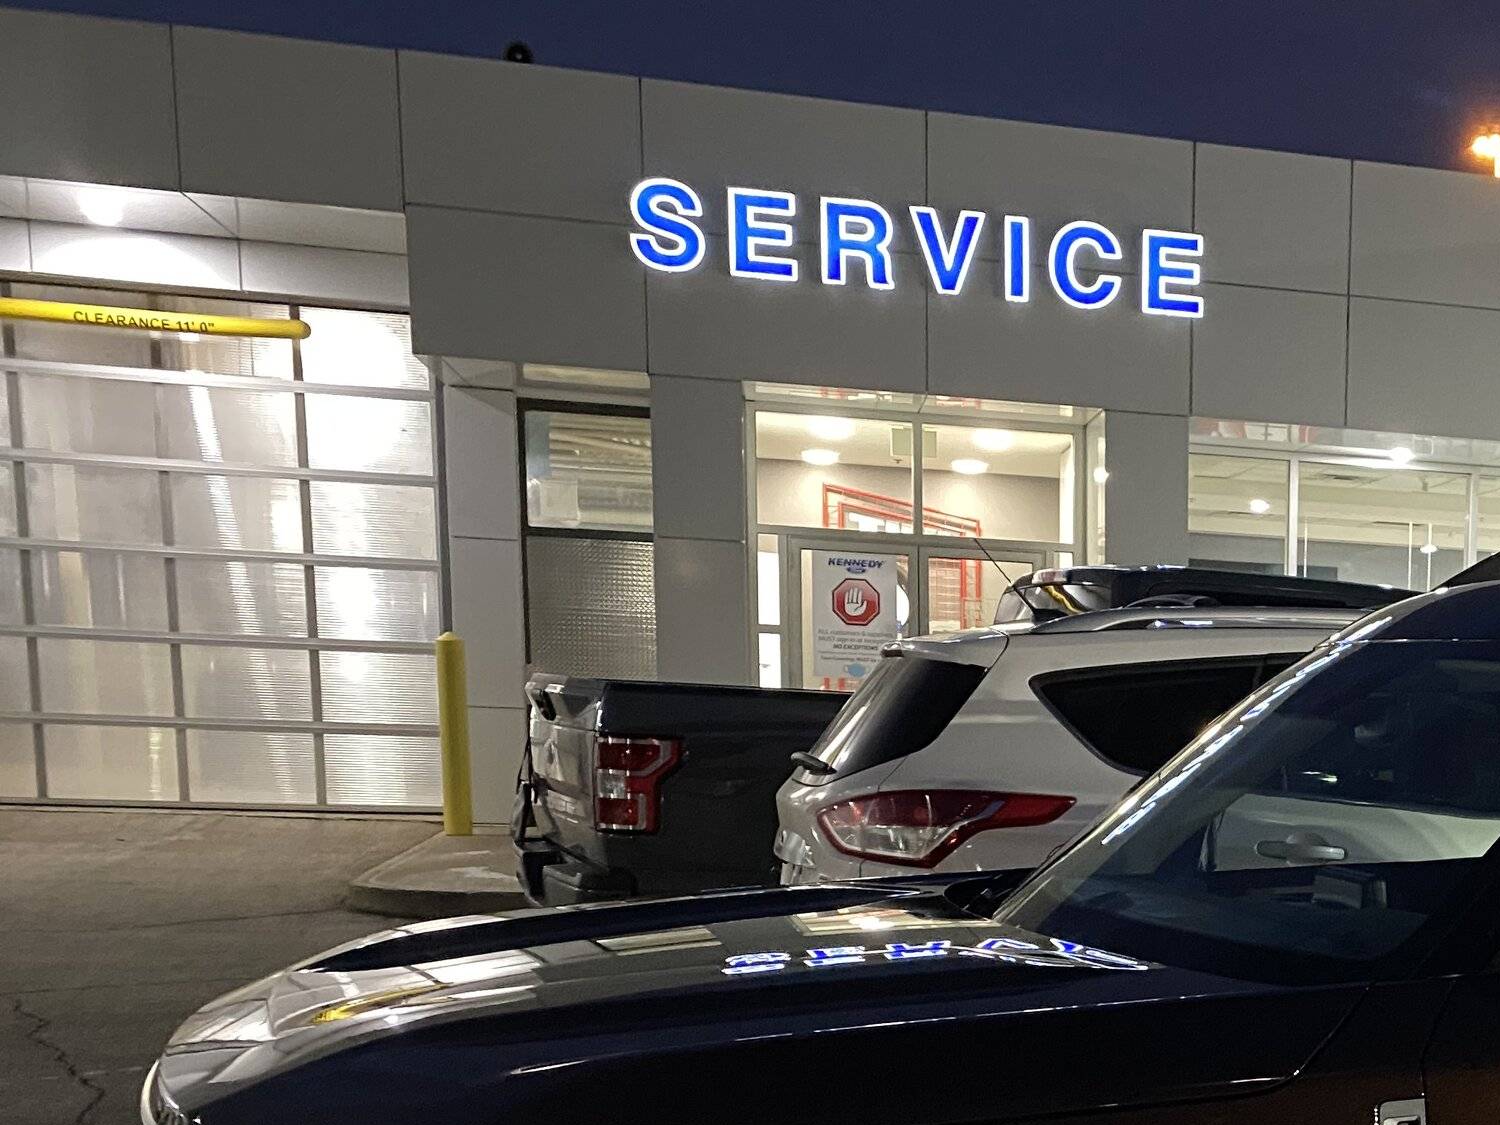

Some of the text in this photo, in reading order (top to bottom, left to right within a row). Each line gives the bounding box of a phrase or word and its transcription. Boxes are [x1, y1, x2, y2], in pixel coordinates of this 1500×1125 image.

[629, 176, 1205, 319] SERVICE
[73, 311, 170, 330] CLEARANCE
[828, 557, 885, 568] KENNEDY
